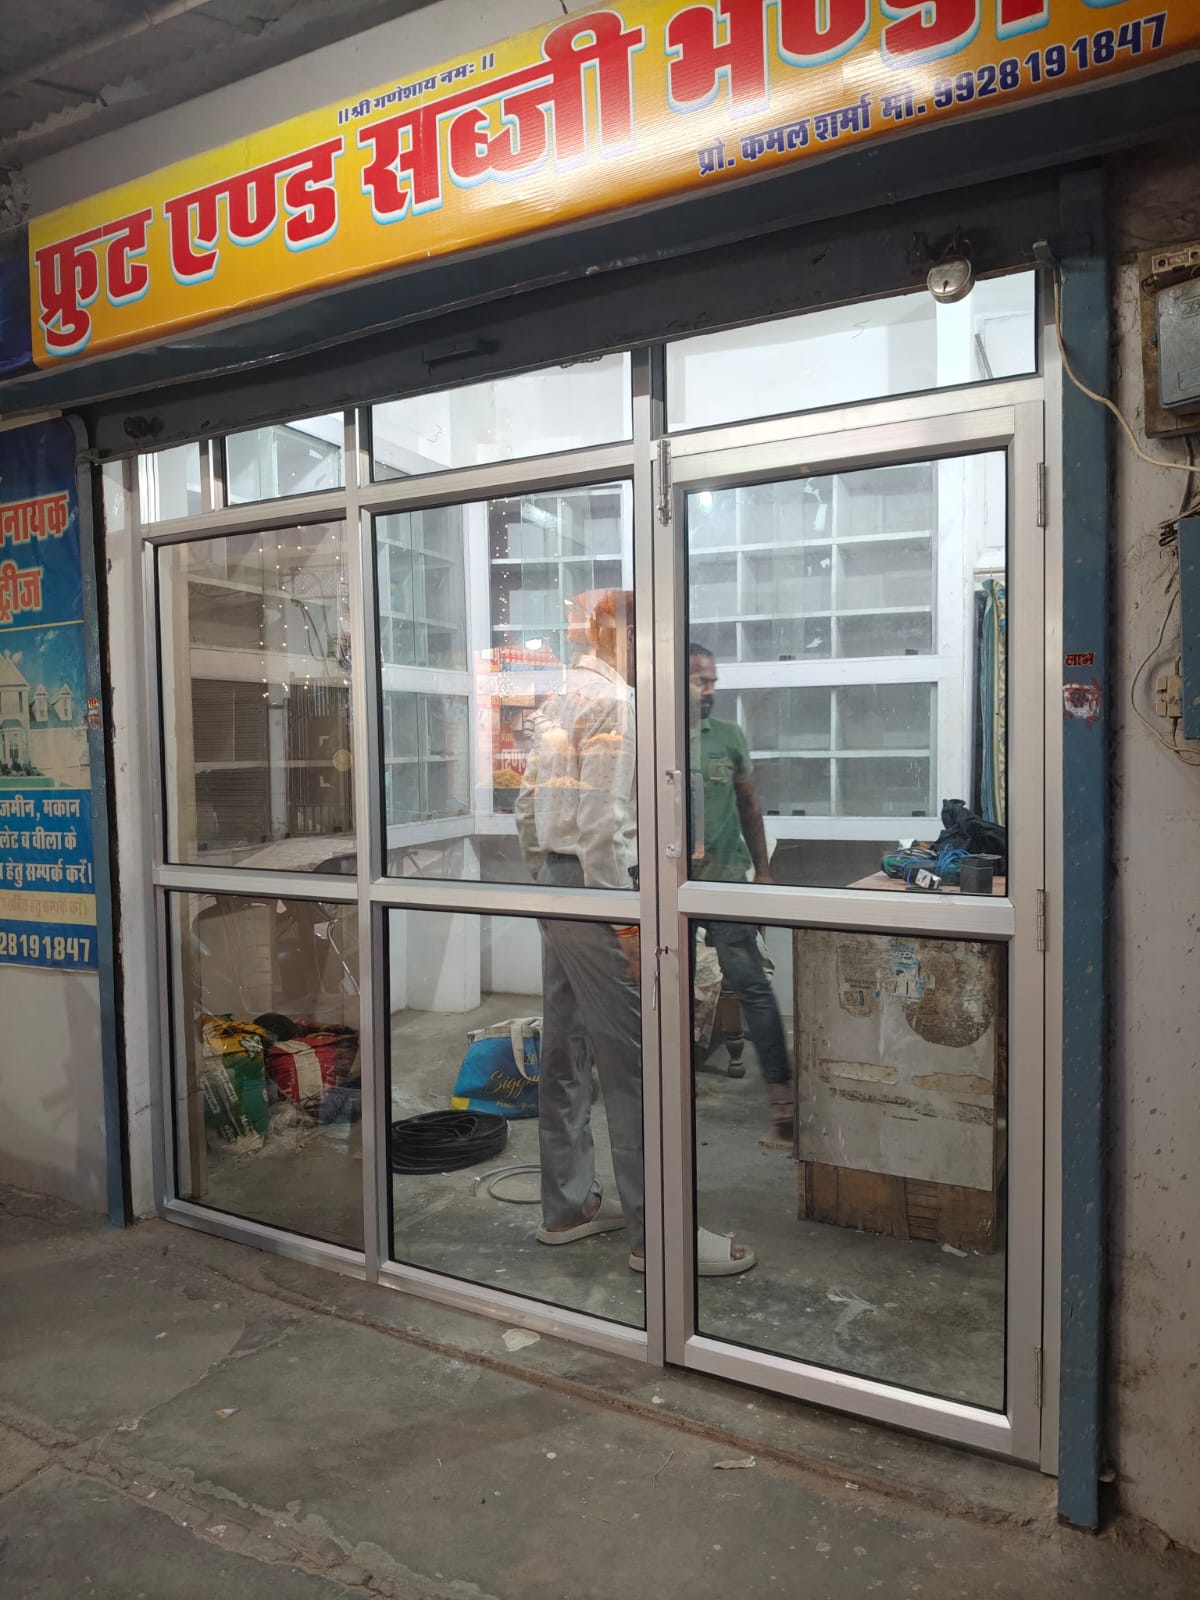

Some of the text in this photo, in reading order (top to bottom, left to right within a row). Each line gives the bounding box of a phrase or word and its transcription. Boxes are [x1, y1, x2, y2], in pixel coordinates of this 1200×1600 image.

[351, 98, 371, 118] श्री
[374, 76, 438, 108] गणेशाय
[697, 137, 735, 176] प्रो.
[740, 118, 810, 160] कमल
[813, 92, 871, 140] शर्मा
[933, 12, 1168, 109] 9928191847
[164, 136, 344, 285] एण्ड
[357, 9, 645, 224] सब्जी
[42, 798, 81, 818] मकान
[32, 826, 63, 850] वीला
[64, 826, 77, 850] के
[6, 858, 24, 888] हेतु
[25, 858, 64, 883] सम्पर्क
